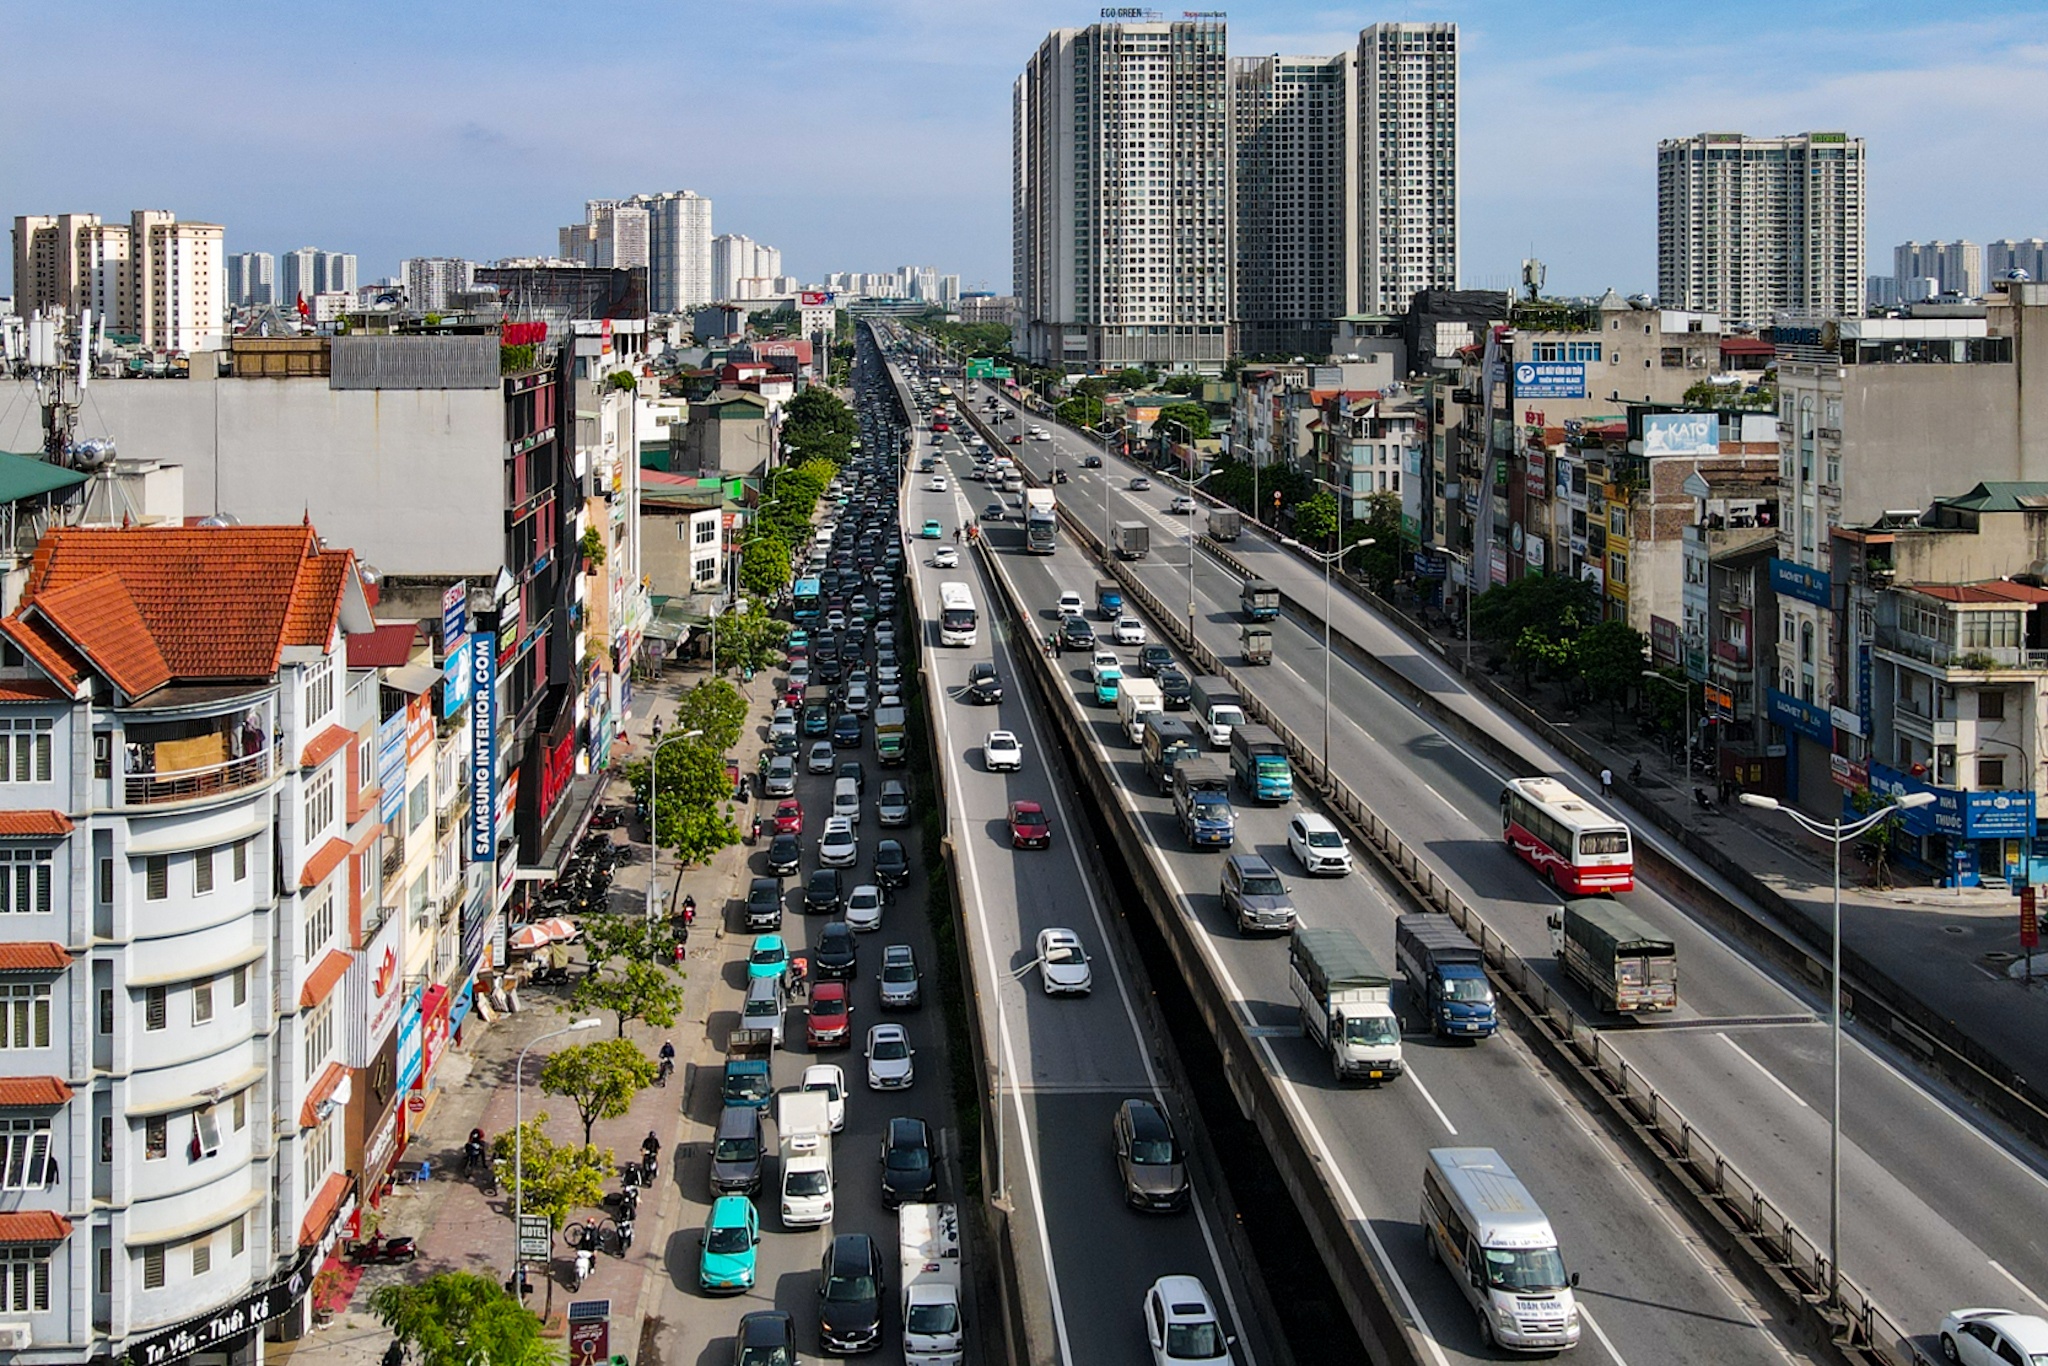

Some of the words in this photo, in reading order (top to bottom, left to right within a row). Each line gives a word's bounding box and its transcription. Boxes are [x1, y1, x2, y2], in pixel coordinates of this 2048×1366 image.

[1100, 8, 1116, 18] ECO
[1118, 8, 1142, 18] GREEN
[1668, 423, 1708, 441] KATO
[475, 640, 490, 766] INTERIOR.COM
[1940, 796, 1958, 810] NHÀ
[475, 769, 490, 855] SAMSUNG
[1935, 813, 1963, 829] THUỐC
[521, 1226, 547, 1237] HOTEL
[169, 1330, 196, 1355] Vấn
[210, 1309, 244, 1339] Thiết
[250, 1295, 269, 1323] Kế
